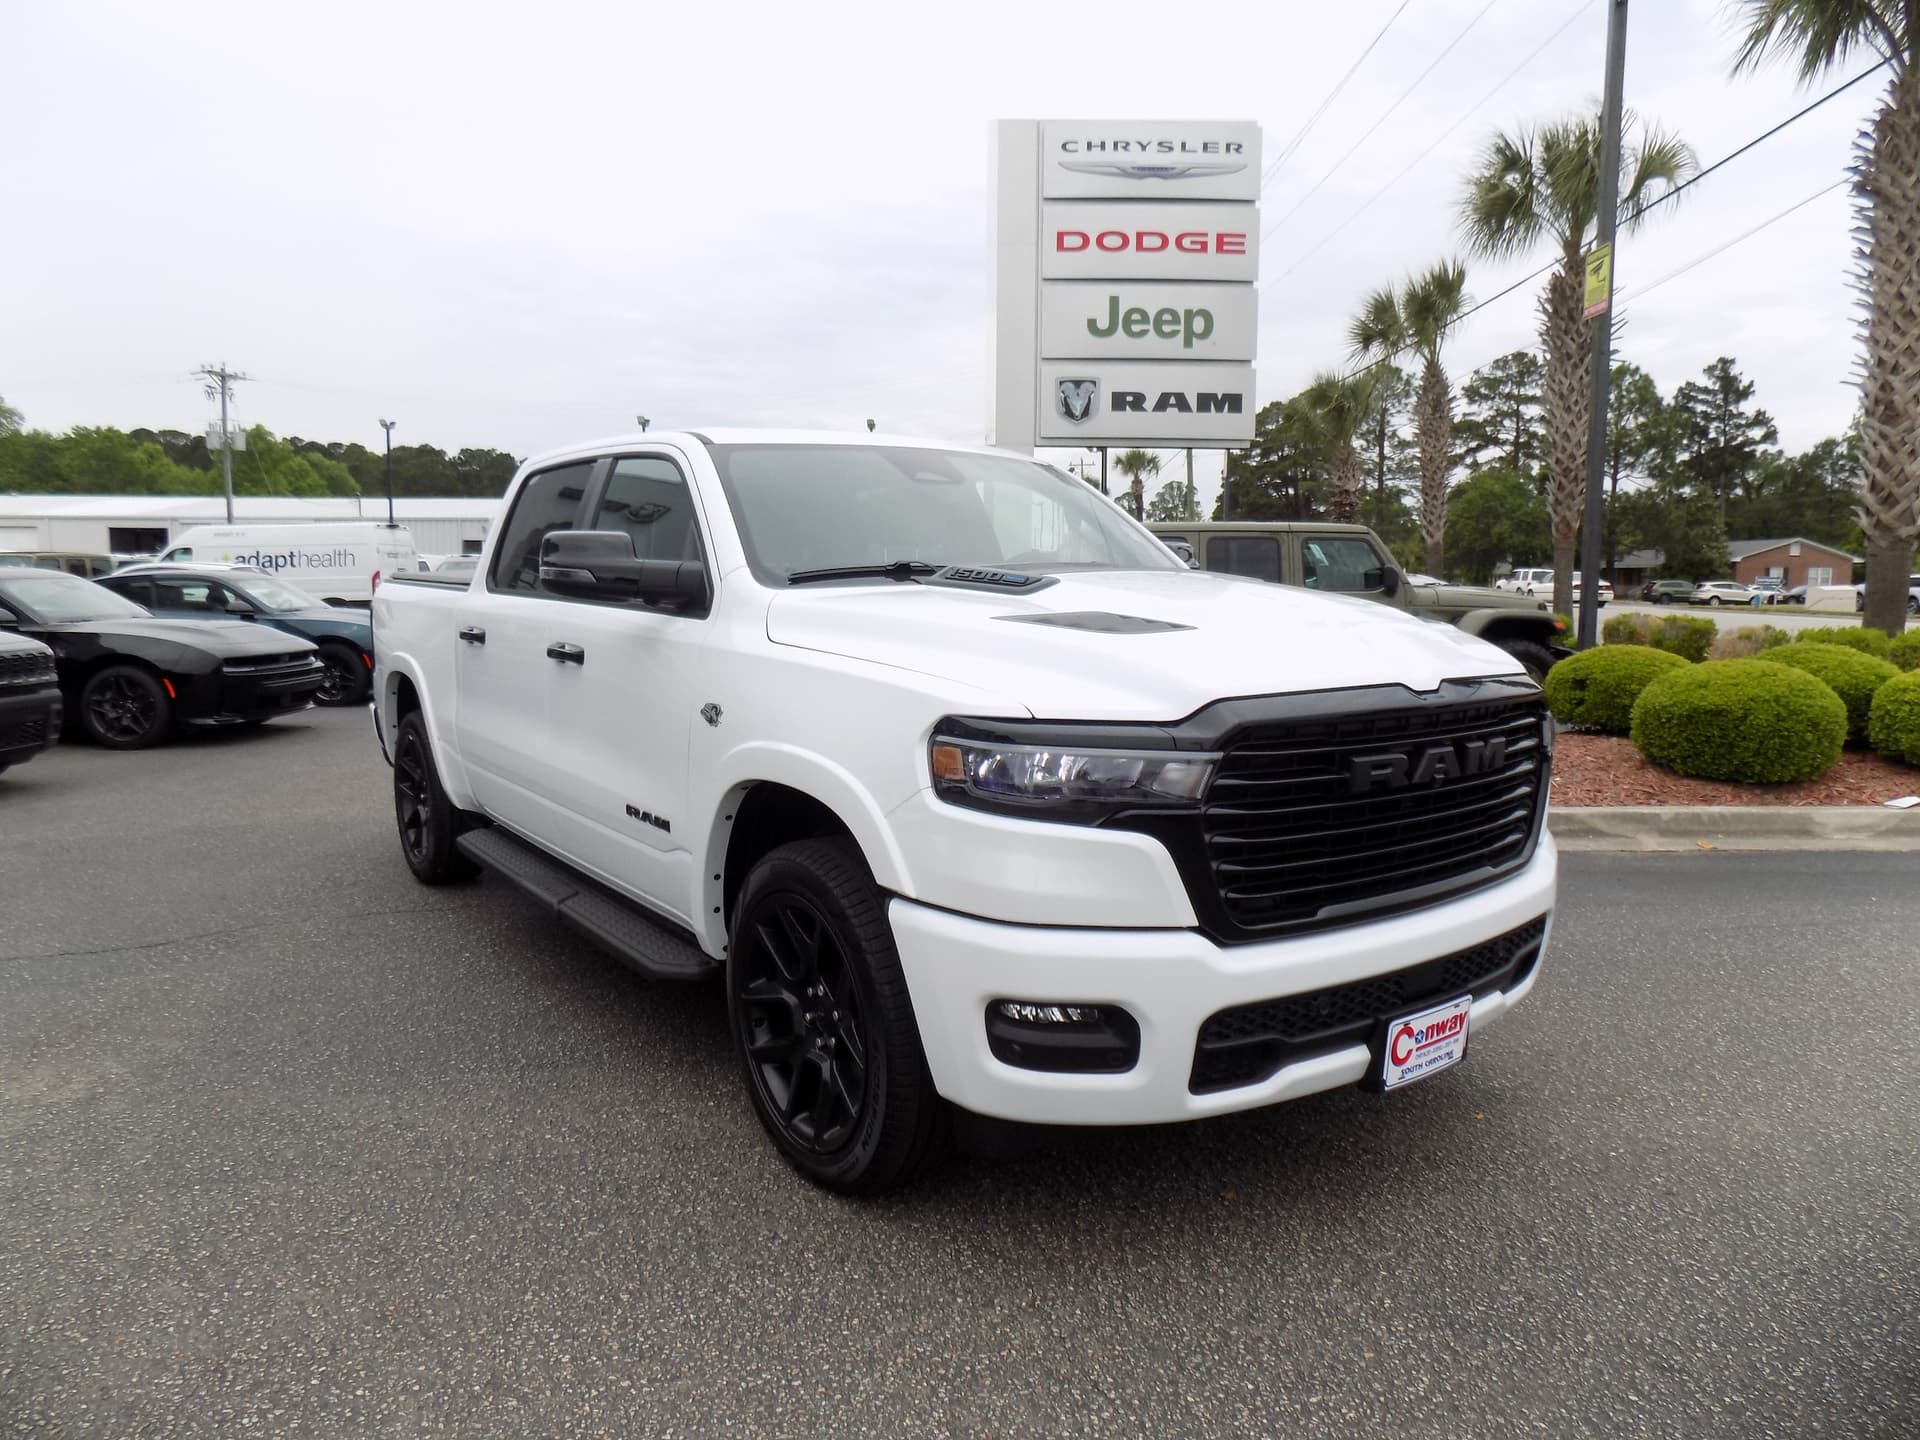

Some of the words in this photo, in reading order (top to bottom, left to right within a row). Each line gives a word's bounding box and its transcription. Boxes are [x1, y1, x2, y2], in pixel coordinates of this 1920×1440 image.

[1060, 140, 1244, 155] CHRYSLER
[1056, 230, 1247, 255] DODGE
[1086, 295, 1215, 349] Jeep
[1111, 391, 1243, 414] RAM
[235, 550, 356, 572] adapthealth
[950, 567, 1004, 581] 1500
[1352, 736, 1507, 792] RAM
[625, 803, 671, 833] RAM
[1391, 1010, 1468, 1067] Conway
[1401, 1063, 1423, 1076] SOUTH
